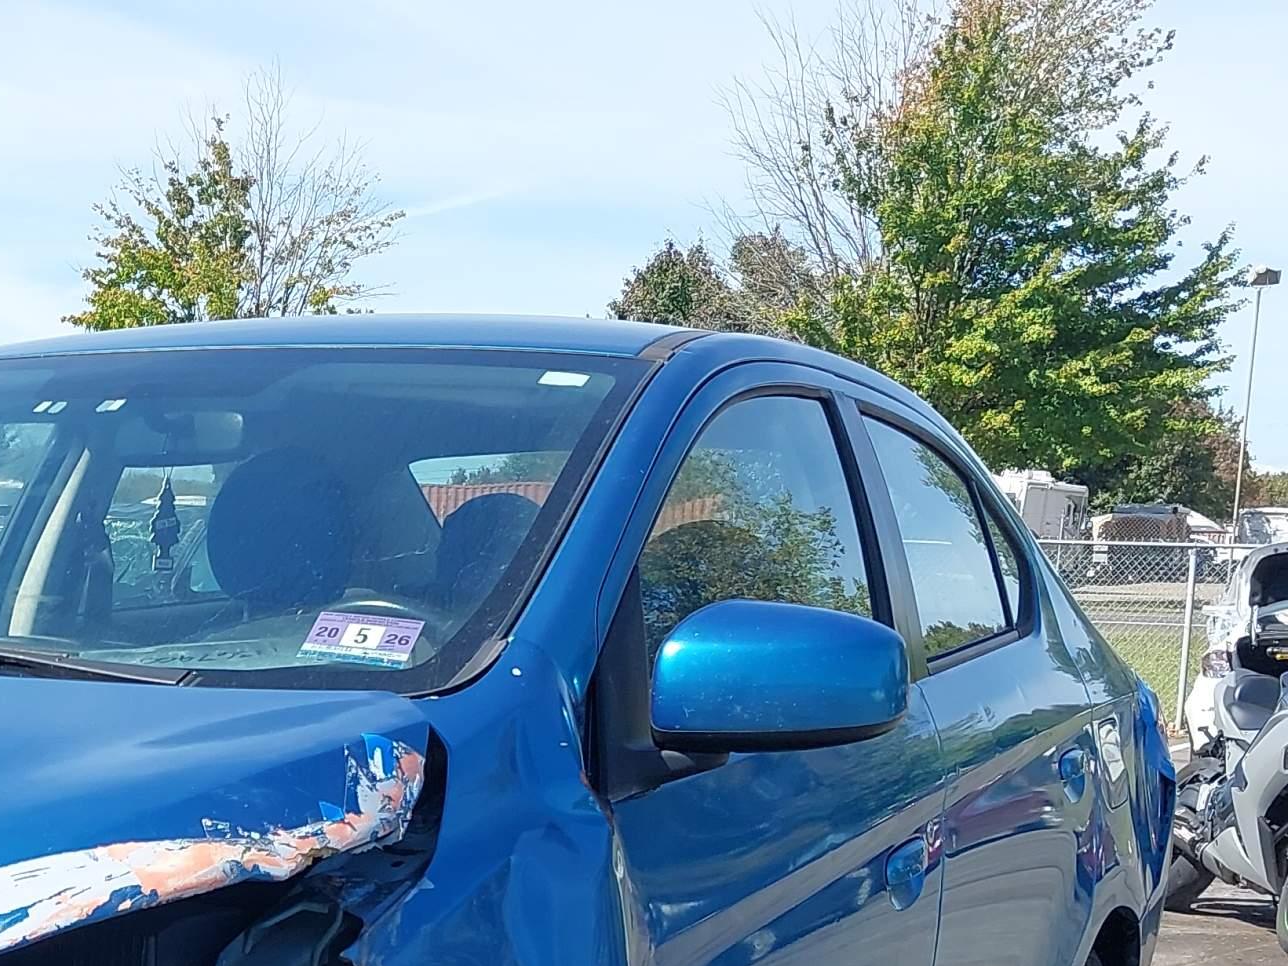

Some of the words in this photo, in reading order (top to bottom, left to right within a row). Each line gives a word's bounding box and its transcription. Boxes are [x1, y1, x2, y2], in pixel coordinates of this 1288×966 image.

[315, 626, 339, 638] 20
[354, 628, 370, 644] 5
[385, 634, 410, 646] 26
